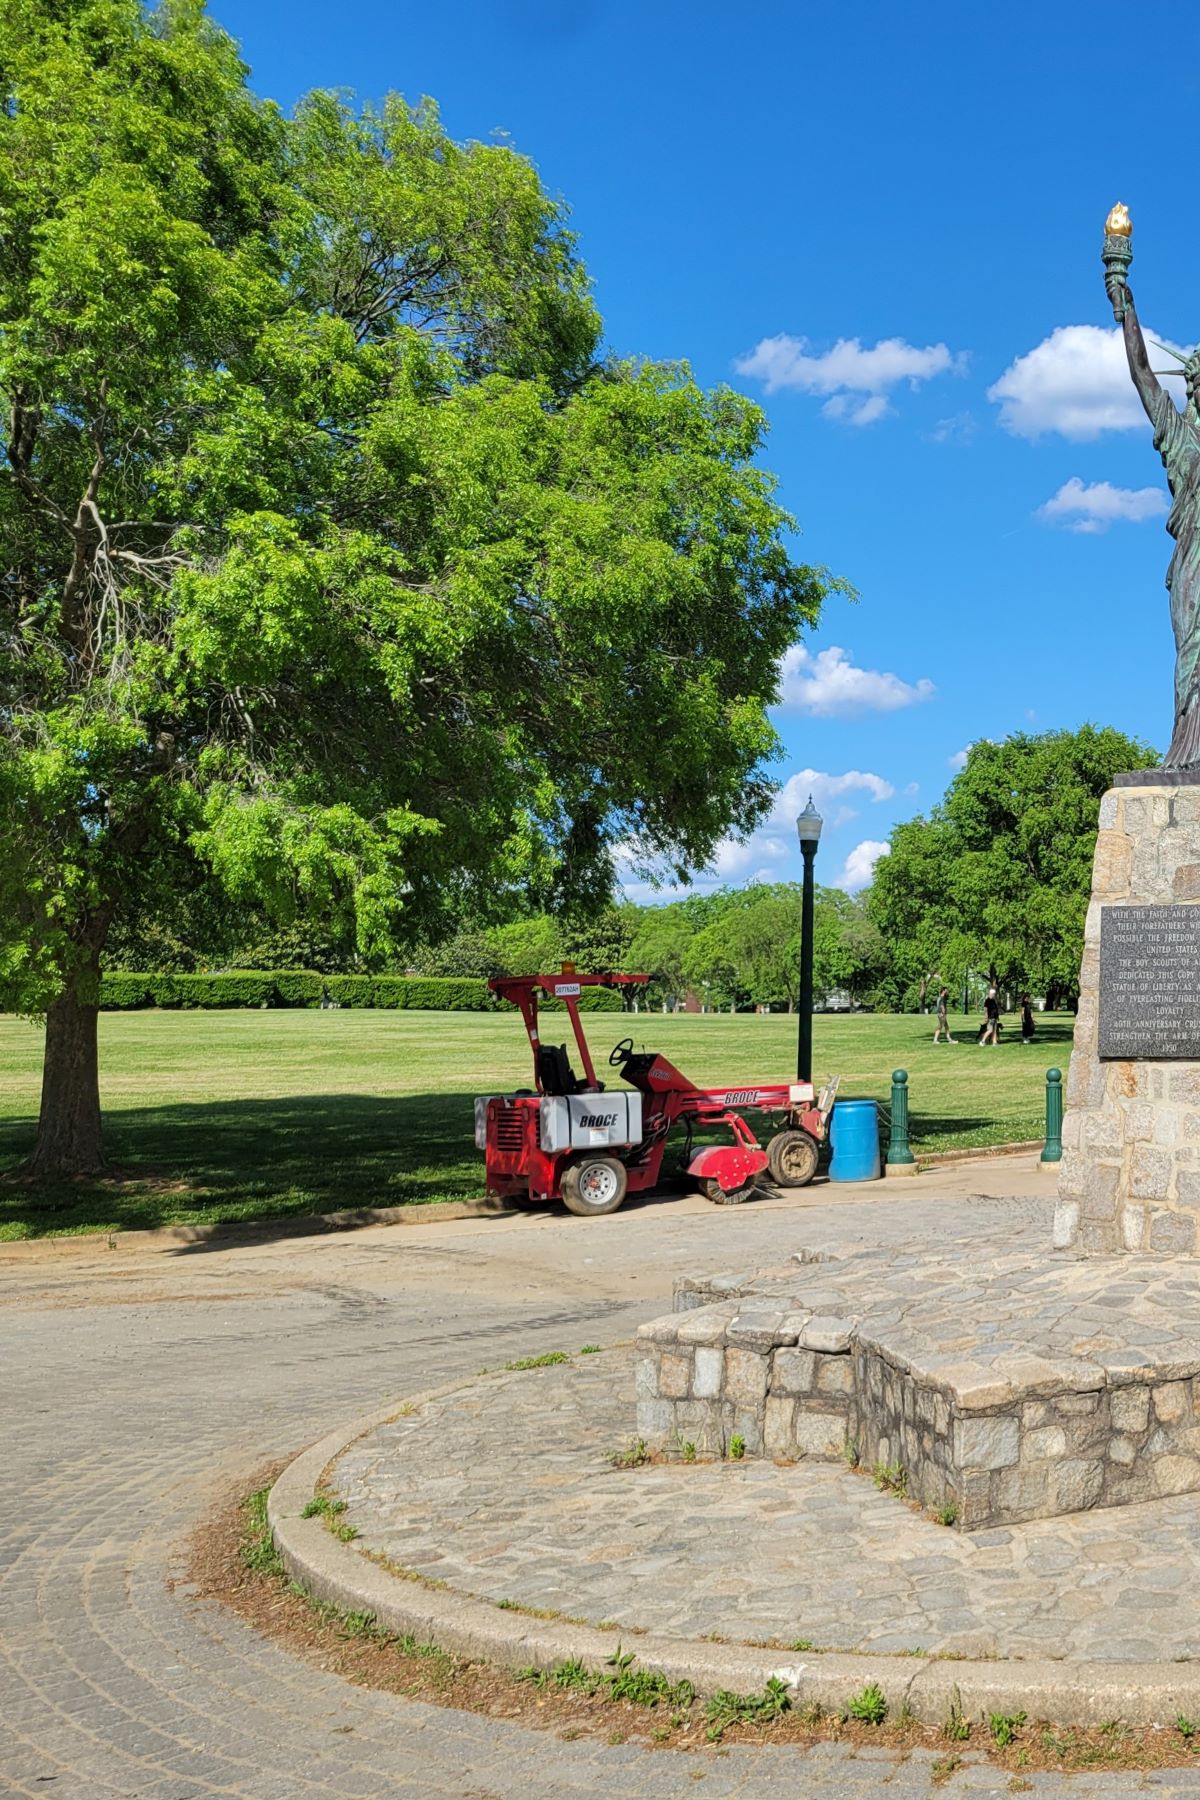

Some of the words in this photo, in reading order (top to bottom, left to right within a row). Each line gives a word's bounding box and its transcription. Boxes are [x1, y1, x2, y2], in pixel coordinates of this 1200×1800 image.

[1133, 911, 1144, 919] THE
[1114, 934, 1143, 942] POSSIBLE
[1164, 934, 1194, 942] FREEDOM
[1136, 1020, 1180, 1028] ANNIVERSARY
[724, 1090, 760, 1104] BROCE
[579, 1114, 618, 1128] BROCE
